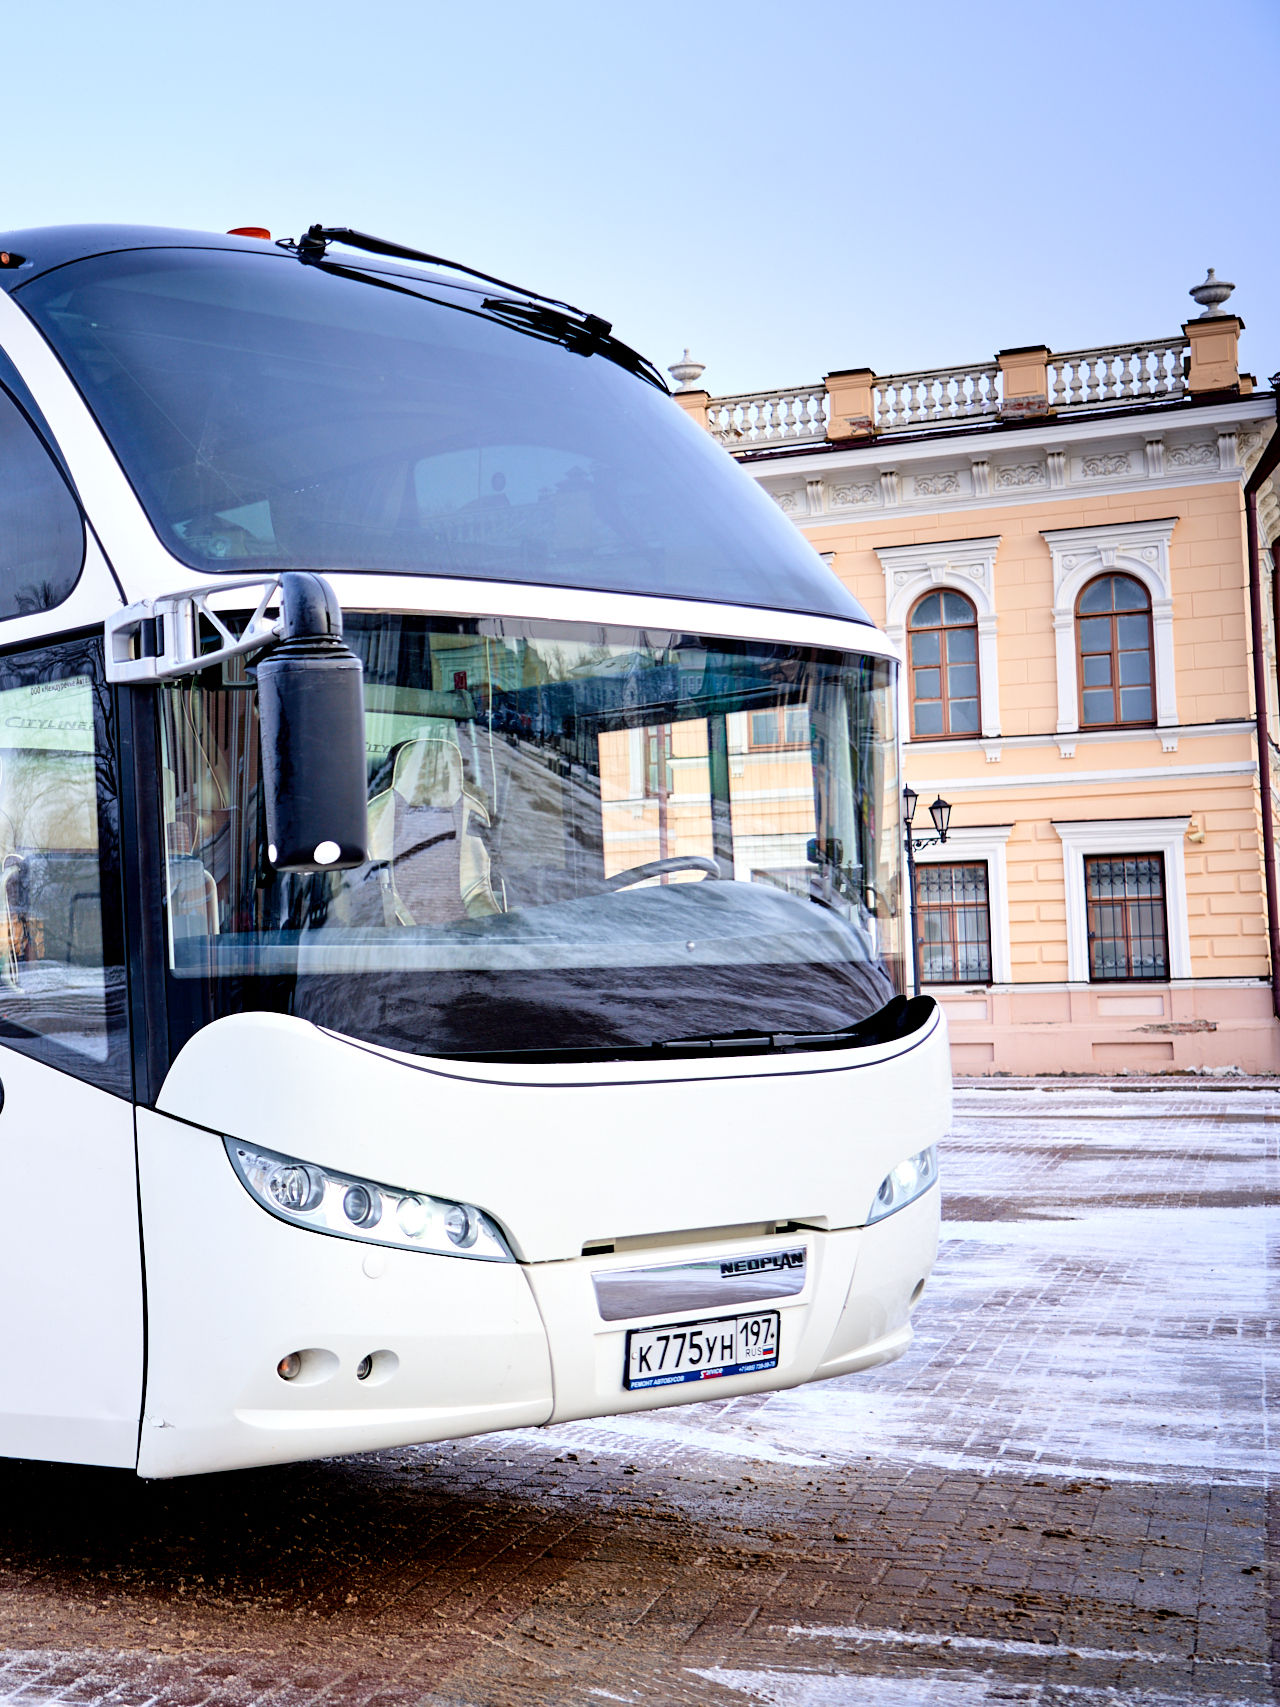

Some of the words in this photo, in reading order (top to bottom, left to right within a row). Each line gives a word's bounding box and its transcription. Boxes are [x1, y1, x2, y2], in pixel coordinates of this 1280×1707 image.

[720, 1251, 804, 1277] NEOPLAN
[638, 1330, 734, 1373] К775УН
[739, 1318, 772, 1347] 197
[745, 1346, 762, 1358] RUS
[630, 1379, 653, 1389] РЕМОНТ
[653, 1375, 685, 1386] АВТОБУСОВ
